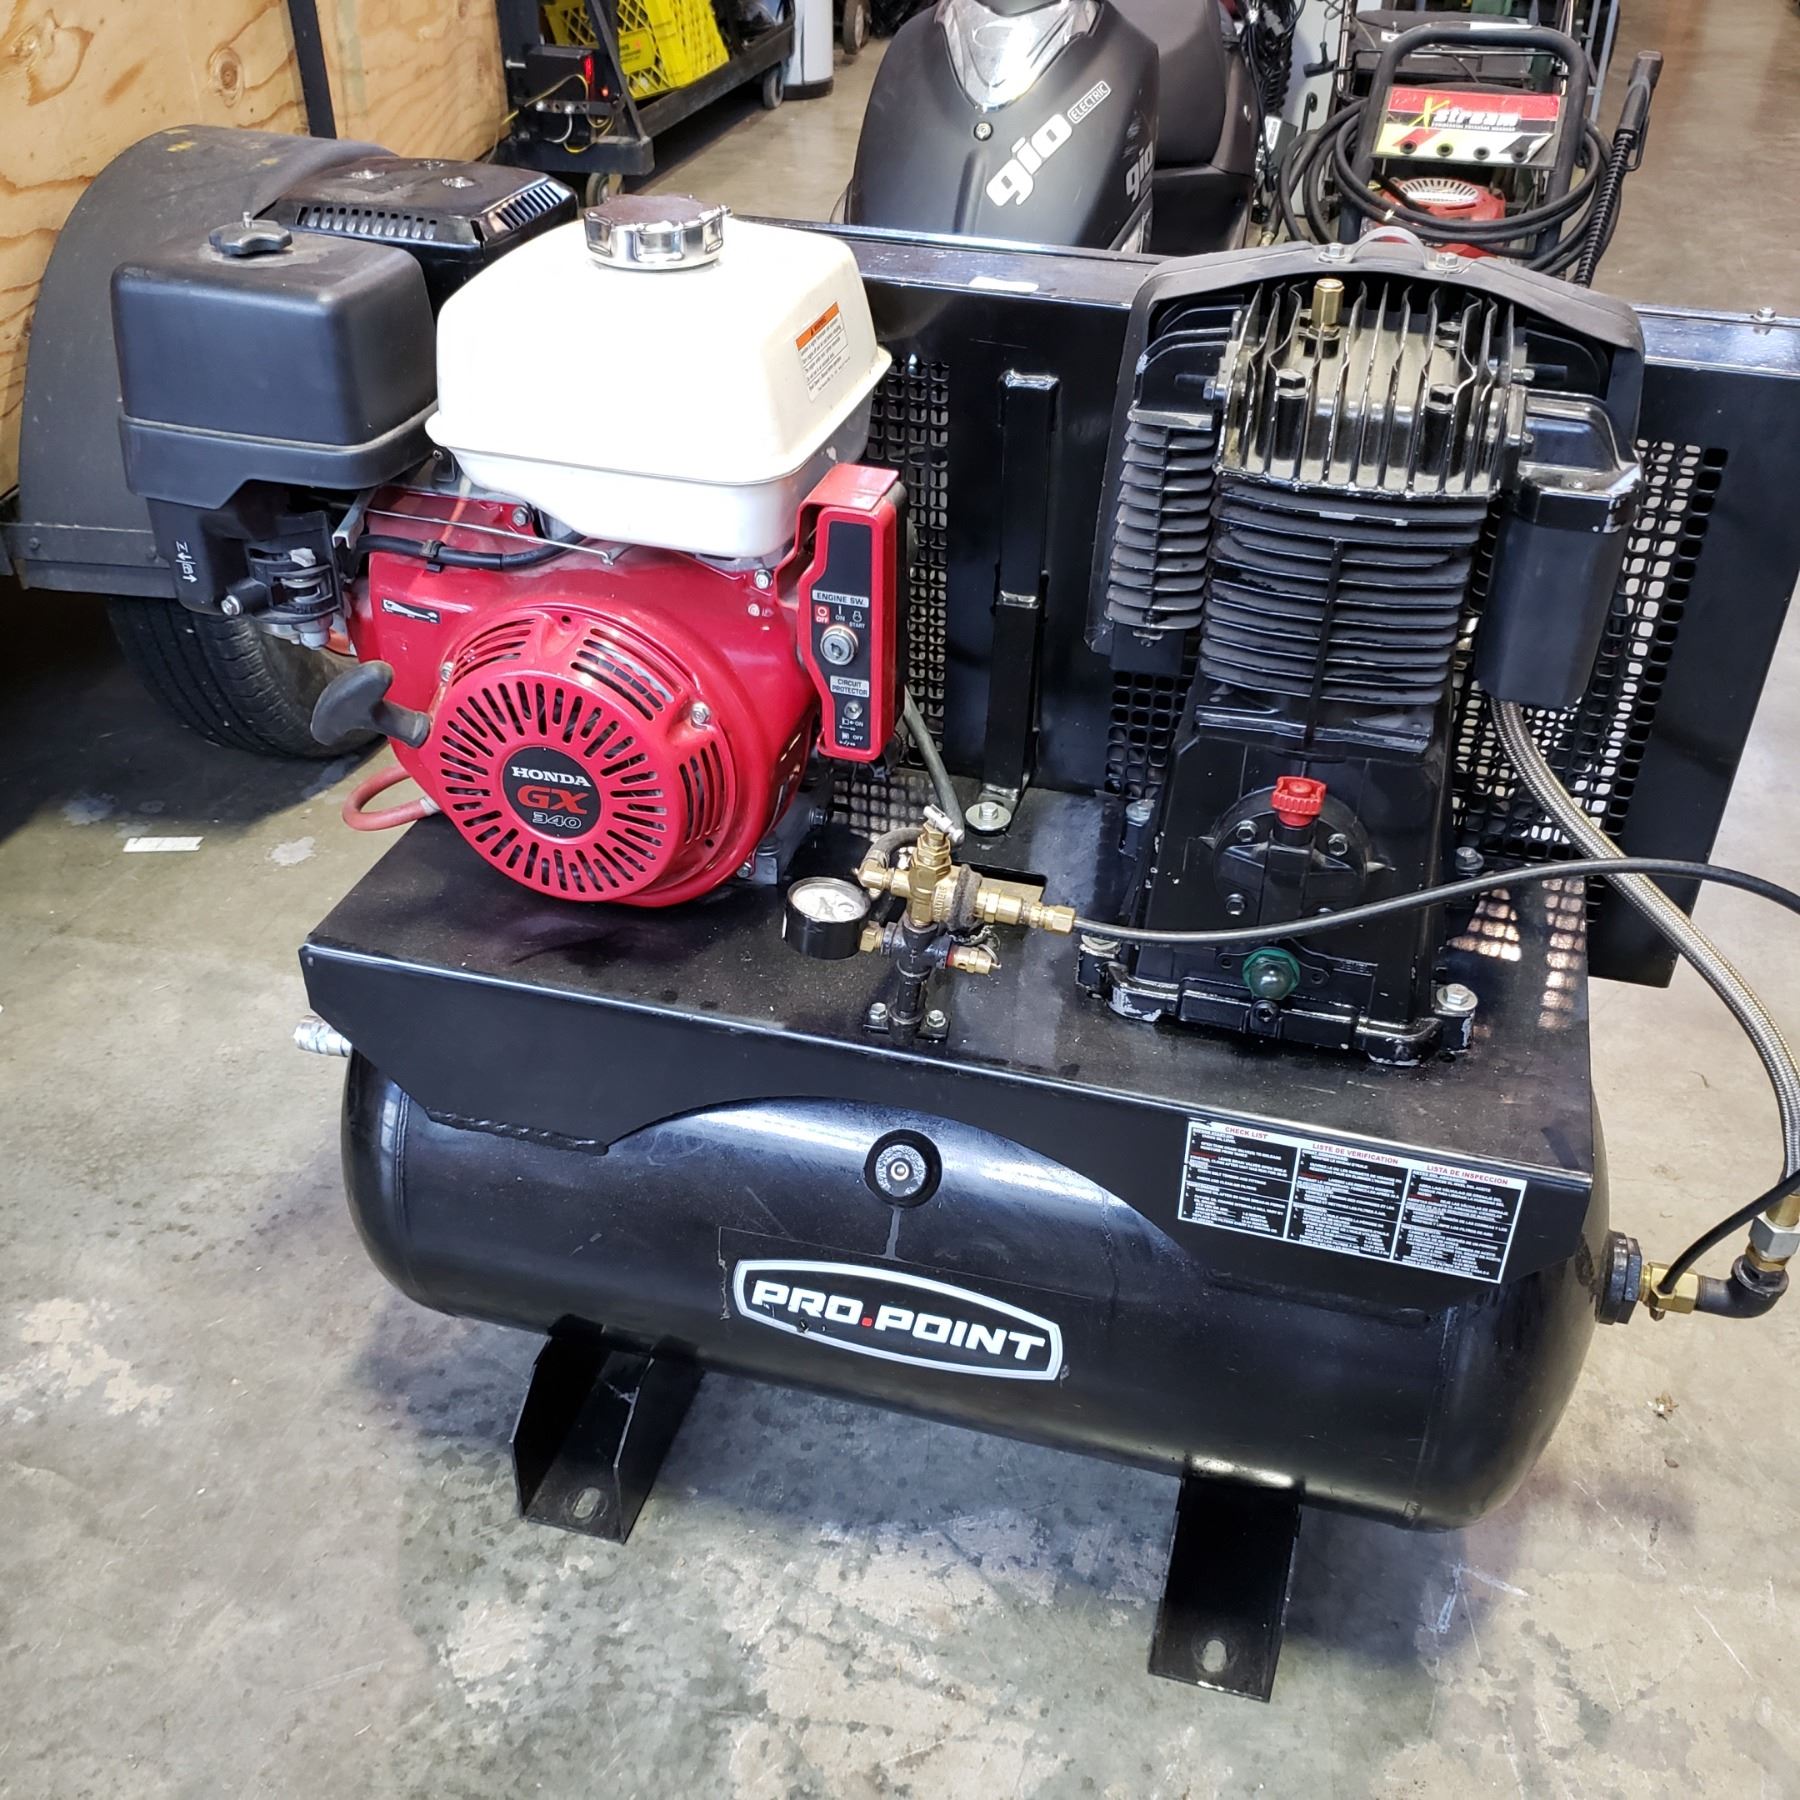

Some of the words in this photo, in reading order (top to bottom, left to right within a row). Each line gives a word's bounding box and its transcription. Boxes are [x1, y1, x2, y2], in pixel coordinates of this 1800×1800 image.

[1071, 83, 1108, 119] ELECTRIC
[985, 114, 1043, 206] gio
[816, 591, 848, 603] ENGINE
[816, 615, 830, 624] OFF
[834, 614, 846, 622] ON
[849, 621, 866, 629] START
[837, 678, 863, 688] CIRCUIT
[831, 684, 868, 697] PROTECTOR
[511, 766, 592, 787] HONDA
[517, 784, 589, 815] GX
[532, 811, 582, 829] 340
[1224, 1125, 1250, 1137] CHECK
[1251, 1132, 1269, 1140] LIST
[1312, 1143, 1334, 1153] LISTE
[1426, 1164, 1449, 1175] LISTA
[1449, 1169, 1461, 1177] DE
